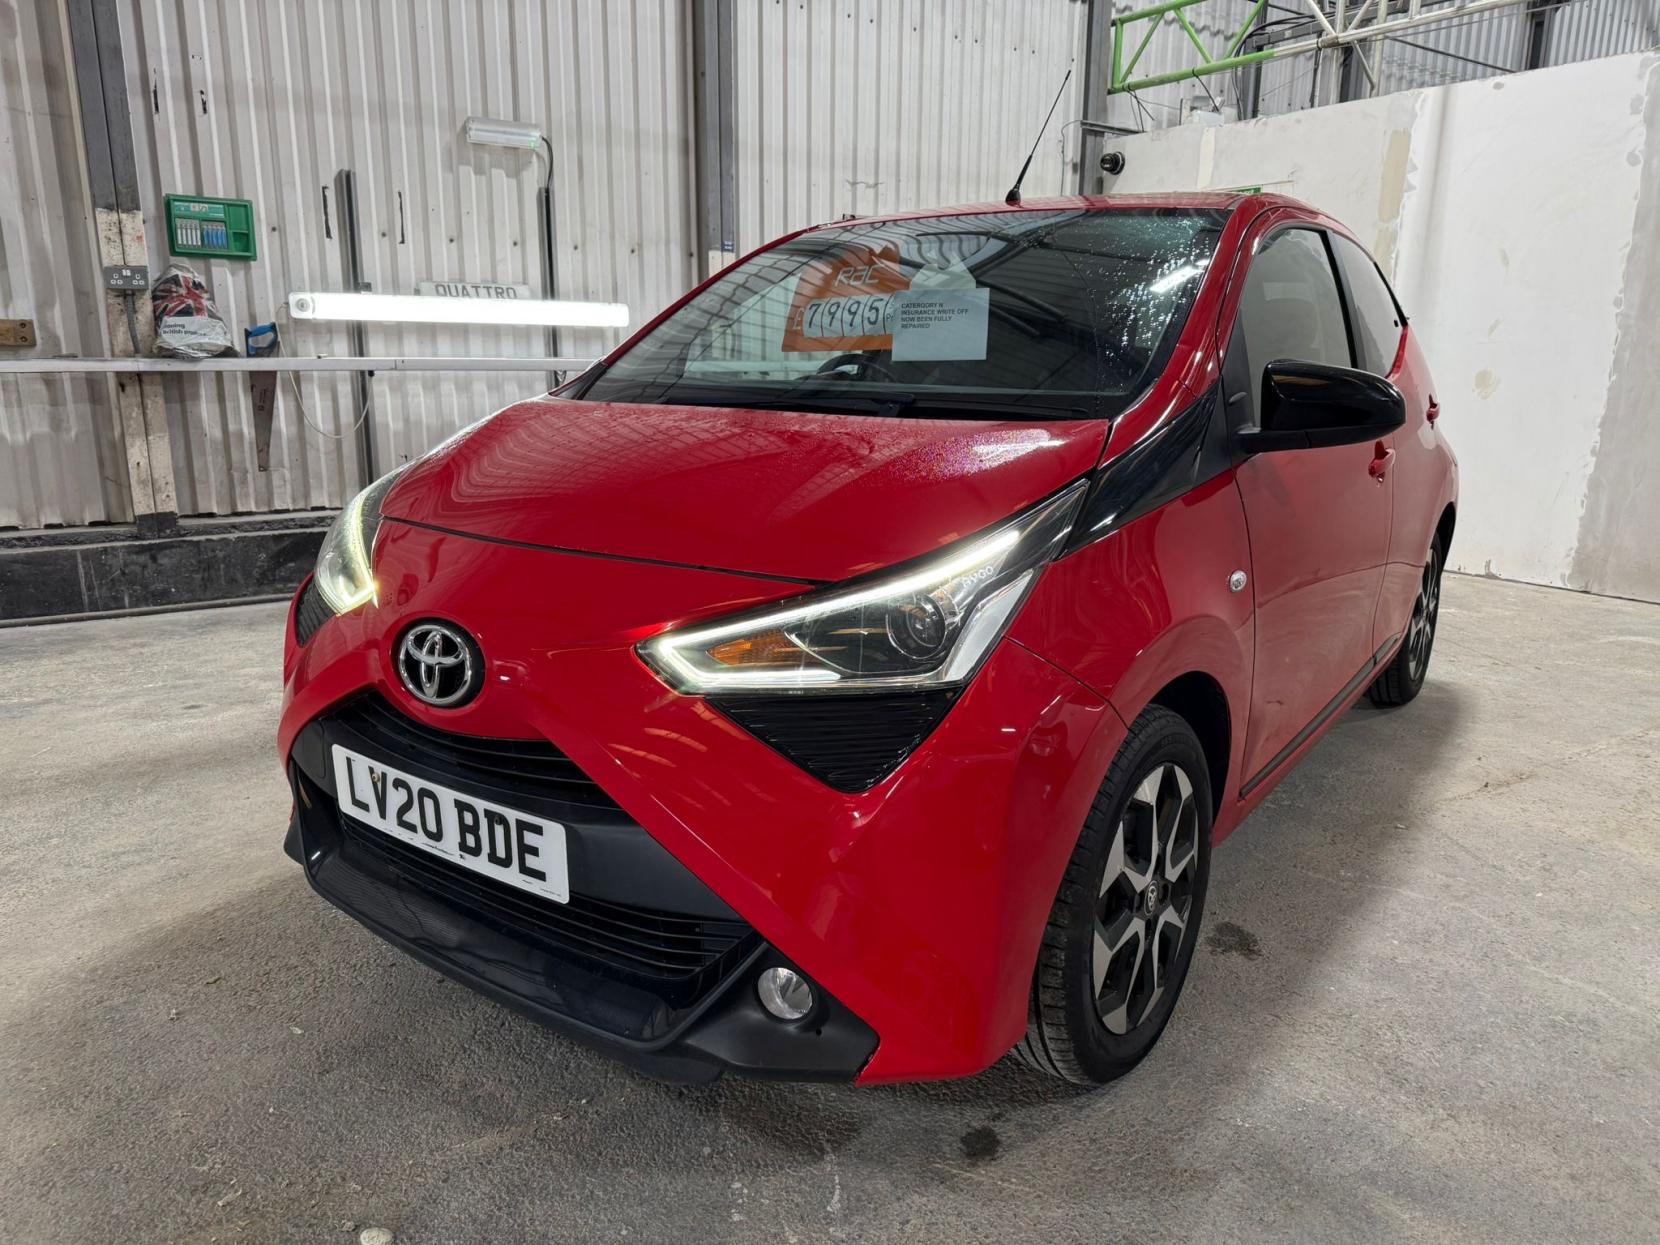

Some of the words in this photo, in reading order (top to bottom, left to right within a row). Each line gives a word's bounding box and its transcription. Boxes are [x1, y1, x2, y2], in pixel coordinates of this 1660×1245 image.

[434, 283, 518, 300] QUATTRO
[901, 308, 935, 316] INSURANCE
[346, 756, 444, 843] LV20
[454, 798, 547, 882] BDE
